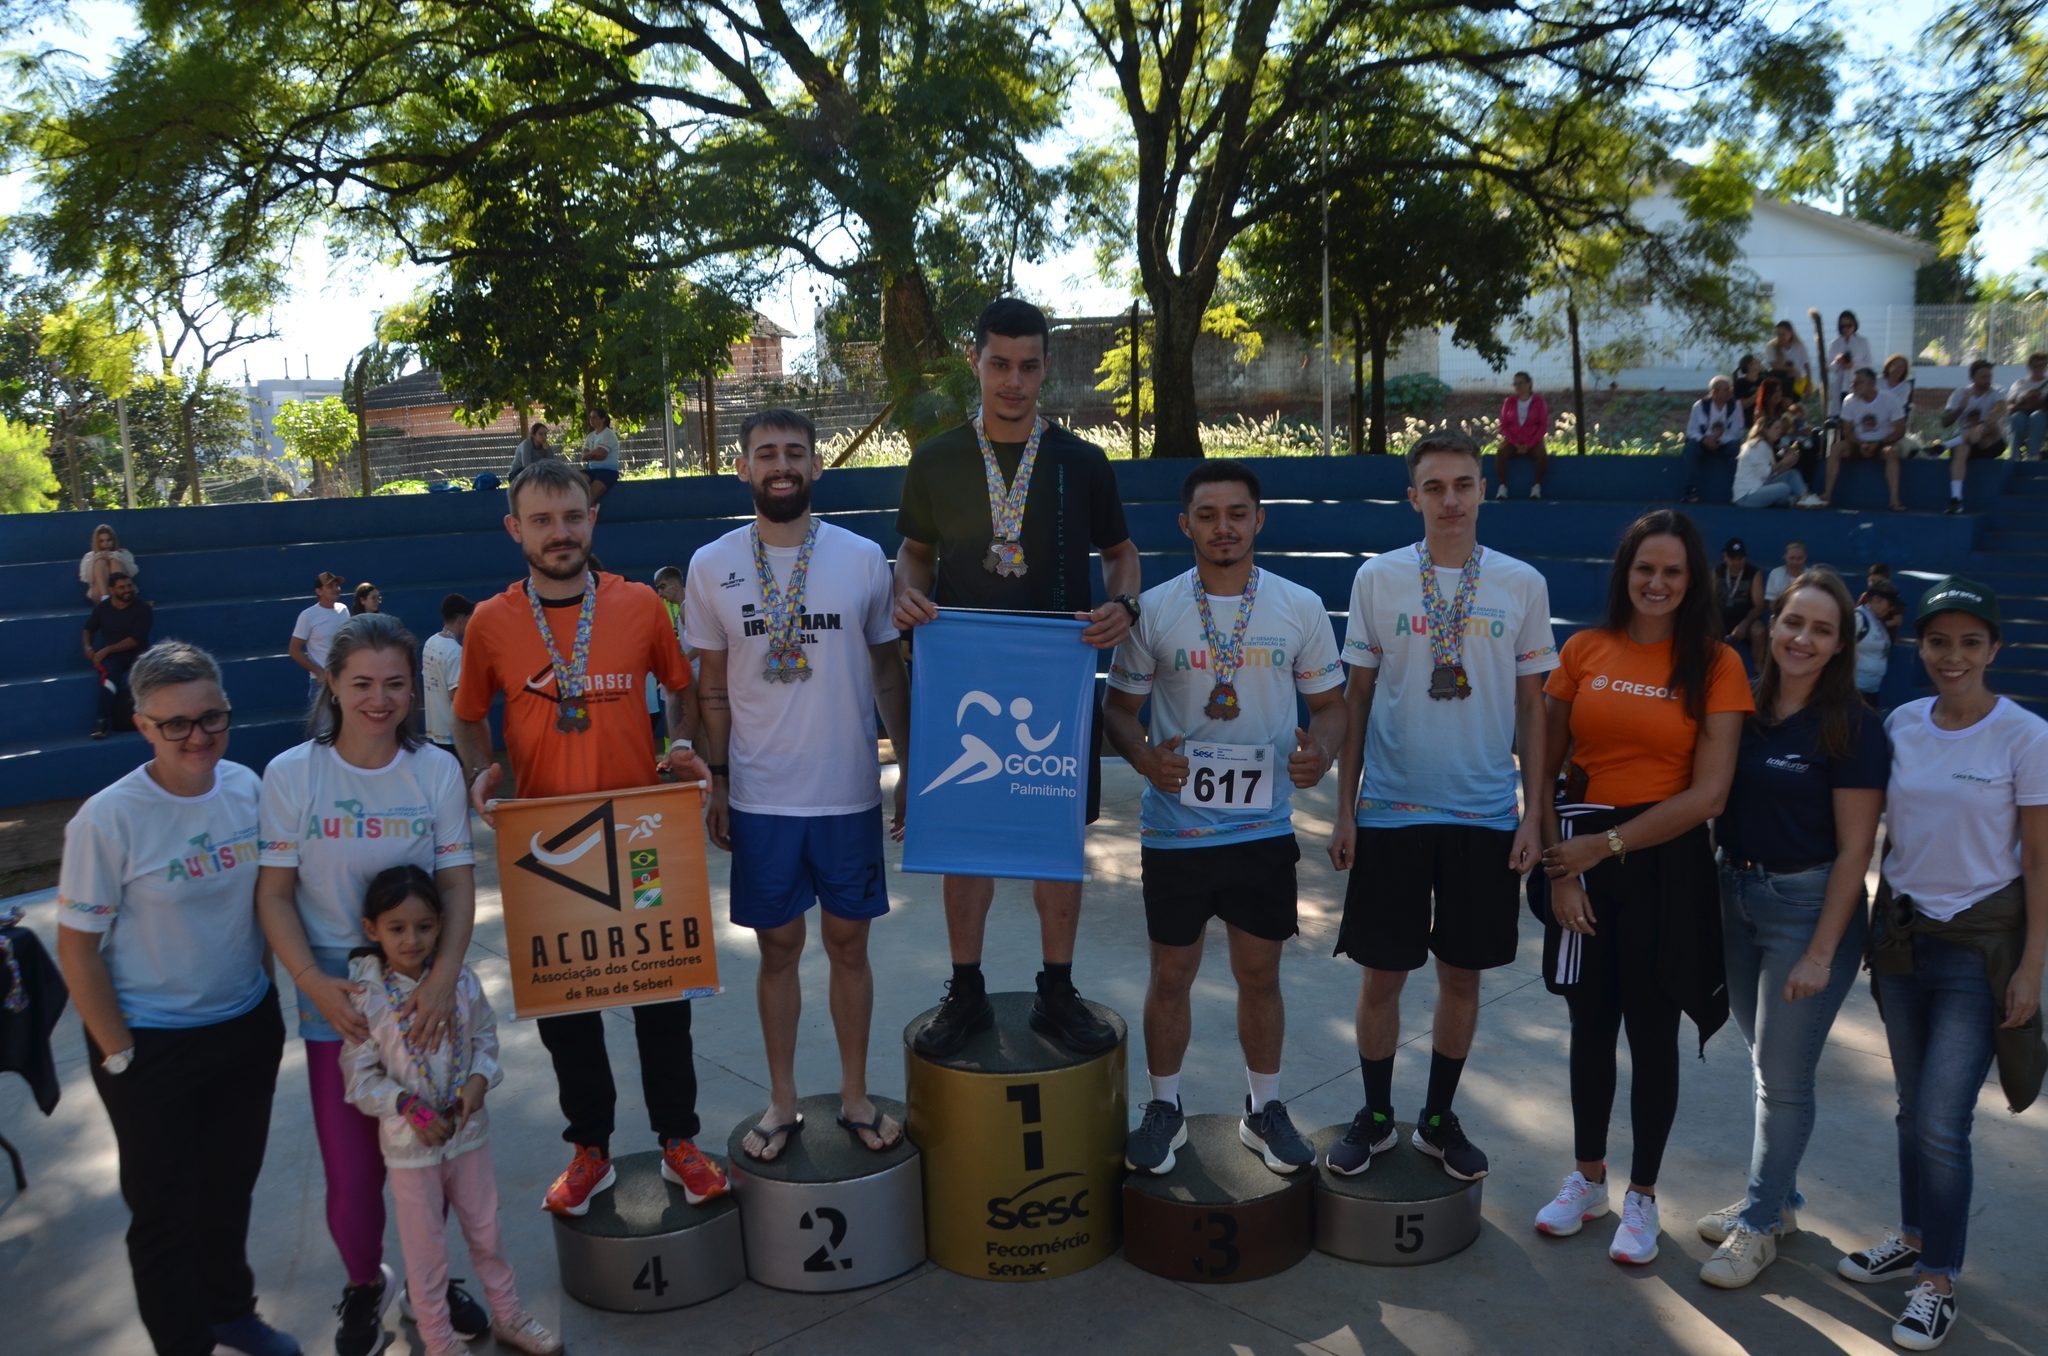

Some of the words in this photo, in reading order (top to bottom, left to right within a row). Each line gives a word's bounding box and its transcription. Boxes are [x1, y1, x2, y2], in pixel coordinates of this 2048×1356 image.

[744, 614, 841, 637] IRMAN
[1010, 782, 1076, 798] Palmitinho
[1193, 767, 1262, 804] 617
[305, 813, 428, 840] Autismo
[167, 840, 258, 882] Autism
[531, 917, 701, 968] ACORSEB
[531, 966, 600, 985] Associação
[605, 963, 628, 976] dos
[631, 954, 702, 972] Corredores
[565, 988, 582, 1000] de
[586, 986, 609, 998] Rua
[613, 982, 629, 994] de
[633, 976, 673, 992] Seberi
[1006, 1083, 1043, 1171] 1
[986, 1188, 1089, 1230] Sesc
[799, 1207, 852, 1272] 2
[986, 1232, 1090, 1257] Fecomércio
[1192, 1212, 1241, 1279] 3
[1394, 1213, 1425, 1254] 5
[633, 1256, 668, 1296] 4
[988, 1261, 1046, 1276] Senac
